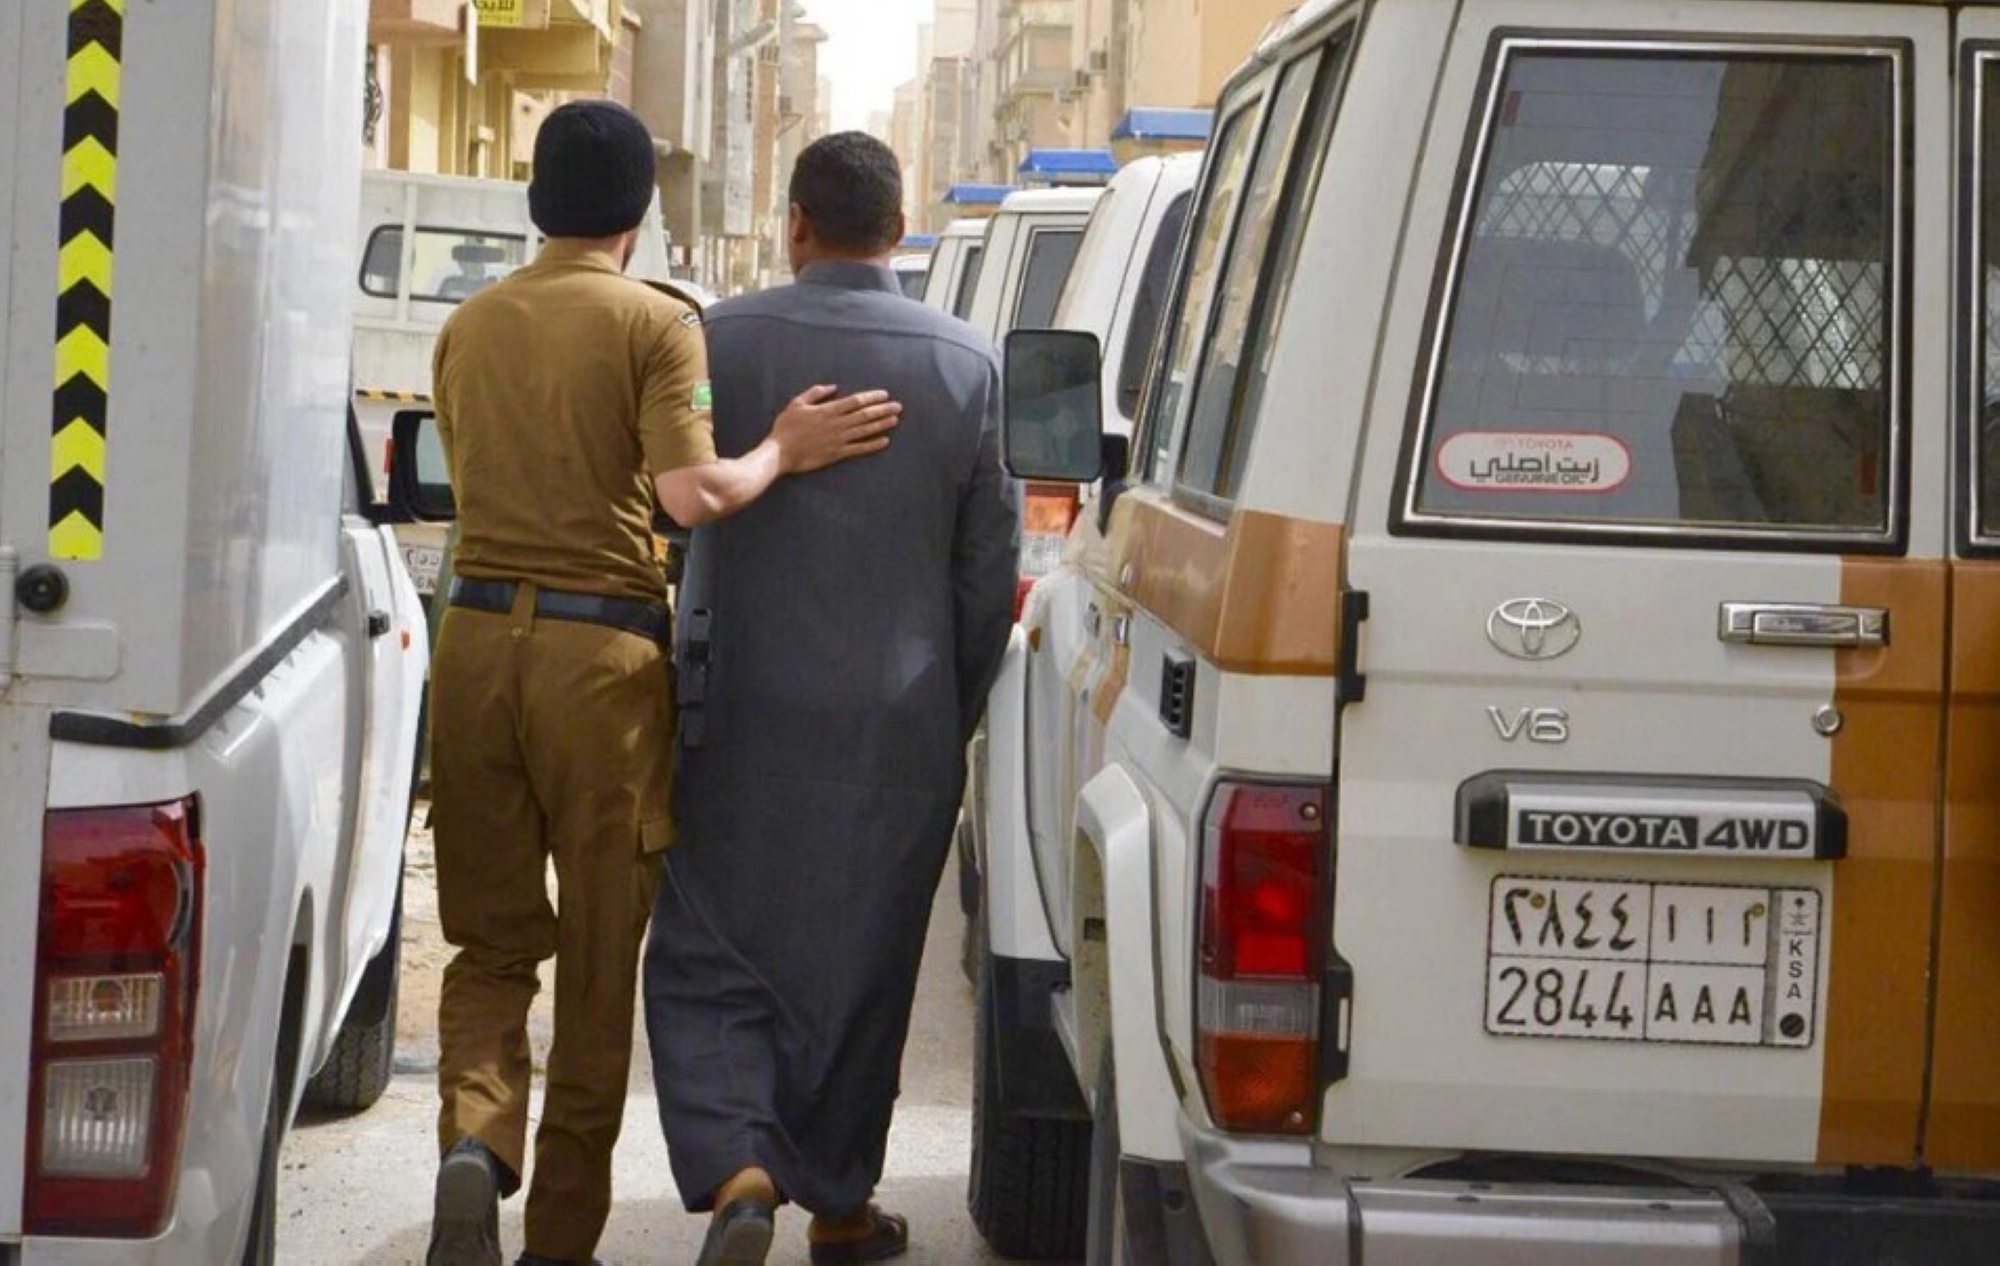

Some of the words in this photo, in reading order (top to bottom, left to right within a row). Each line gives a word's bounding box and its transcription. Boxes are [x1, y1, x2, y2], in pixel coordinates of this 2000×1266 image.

[1517, 438, 1574, 450] TOYOTA
[1486, 705, 1569, 743] V6
[1527, 812, 1690, 847] TOYOTA
[1703, 819, 1810, 851] 4WD
[1503, 888, 1637, 951] ٢٨٤٤
[1786, 938, 1804, 999] KSA
[1496, 966, 1634, 1030] 2844
[1654, 982, 1752, 1026] AAA
